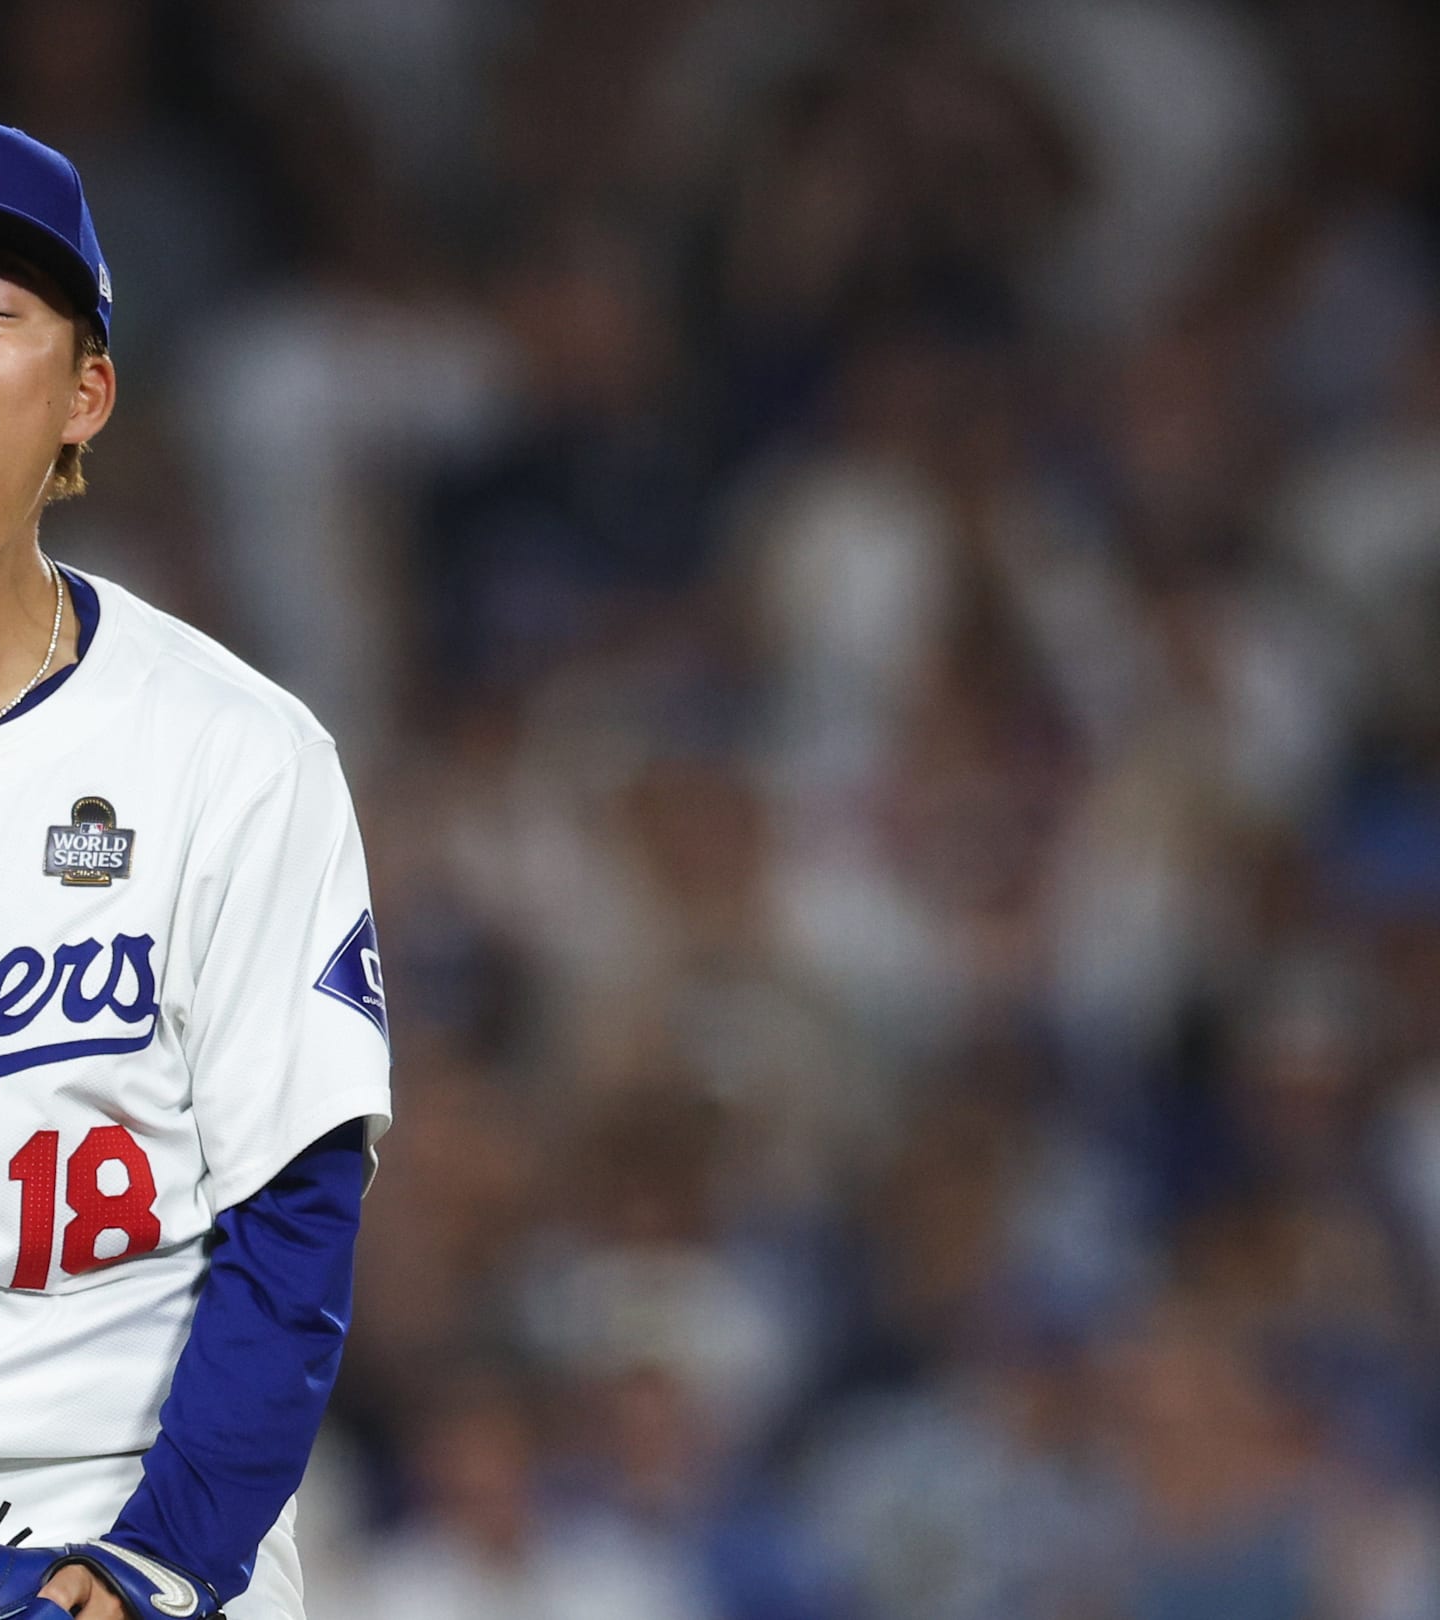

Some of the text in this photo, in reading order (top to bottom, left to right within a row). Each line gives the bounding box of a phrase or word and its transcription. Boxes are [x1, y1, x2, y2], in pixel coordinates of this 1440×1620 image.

[52, 833, 128, 852] WORLD
[53, 850, 124, 869] SERIES
[9, 1125, 161, 1291] 18
